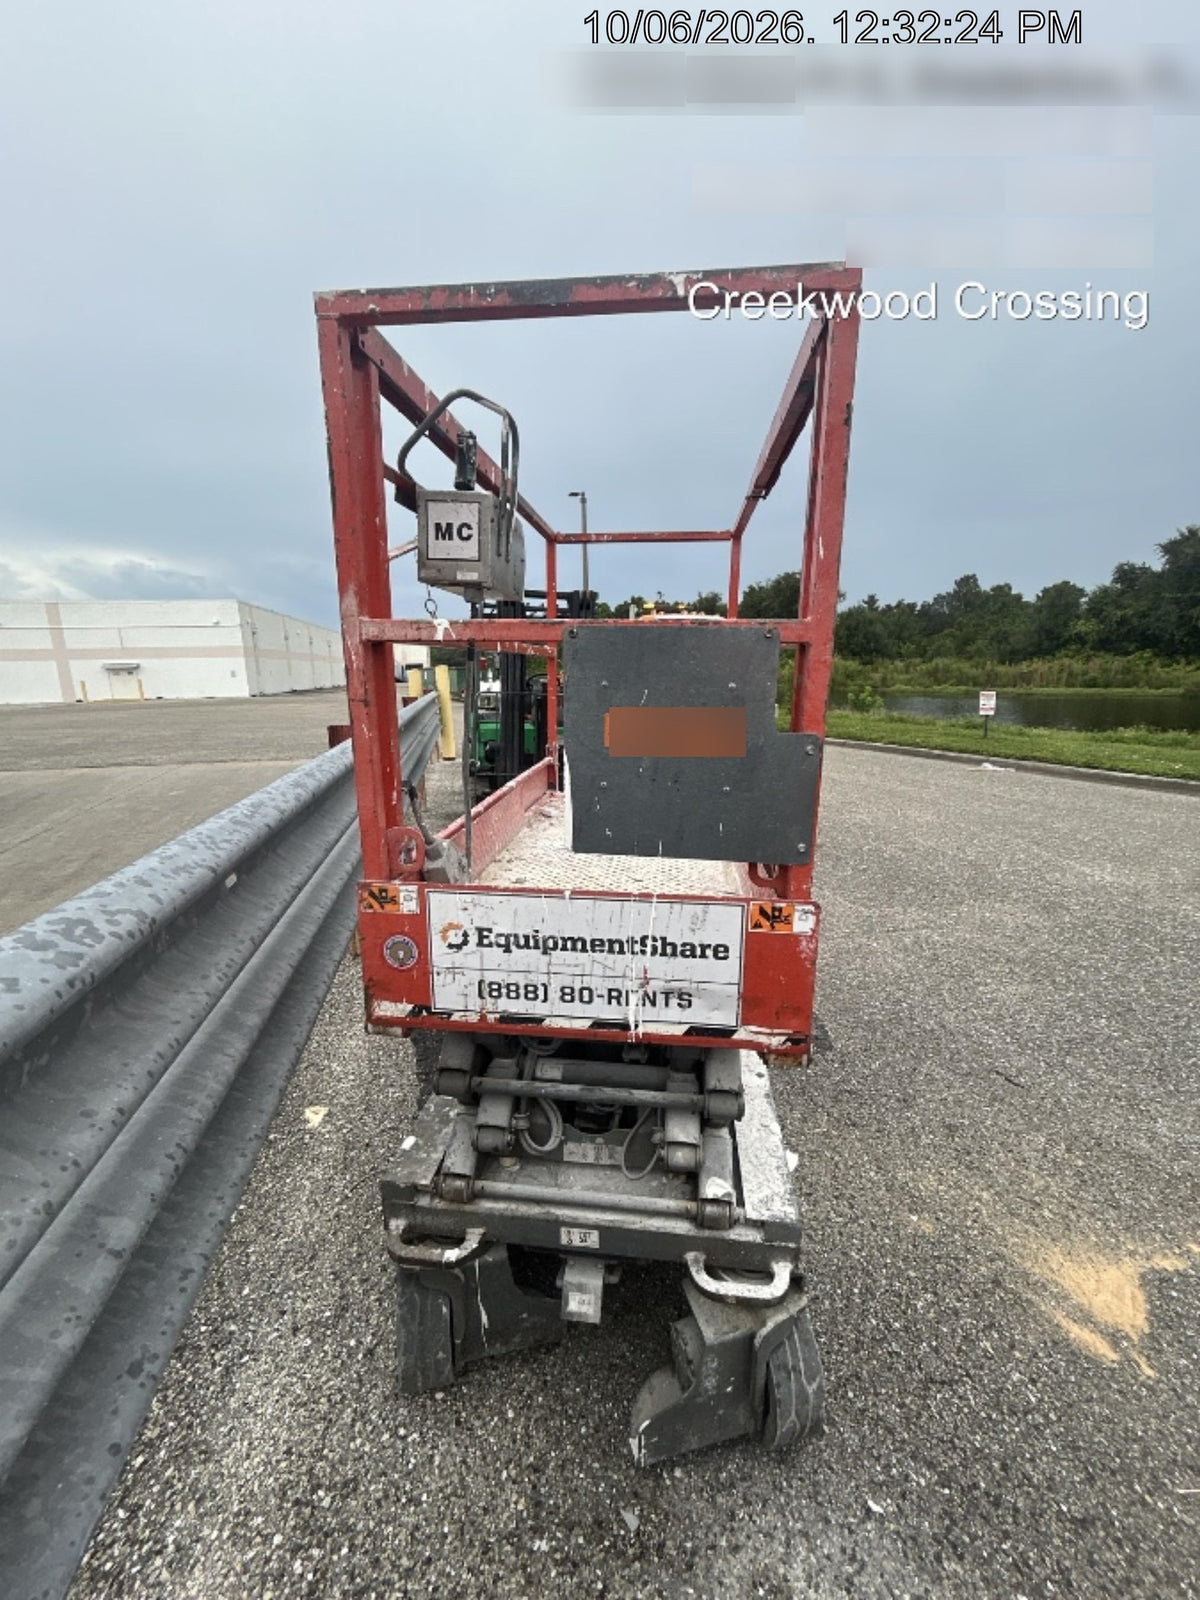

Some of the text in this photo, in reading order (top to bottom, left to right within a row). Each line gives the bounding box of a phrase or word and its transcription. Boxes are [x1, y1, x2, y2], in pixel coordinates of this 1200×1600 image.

[434, 522, 474, 541] MC
[475, 926, 731, 961] EquipmentShare
[477, 979, 548, 1003] (888)
